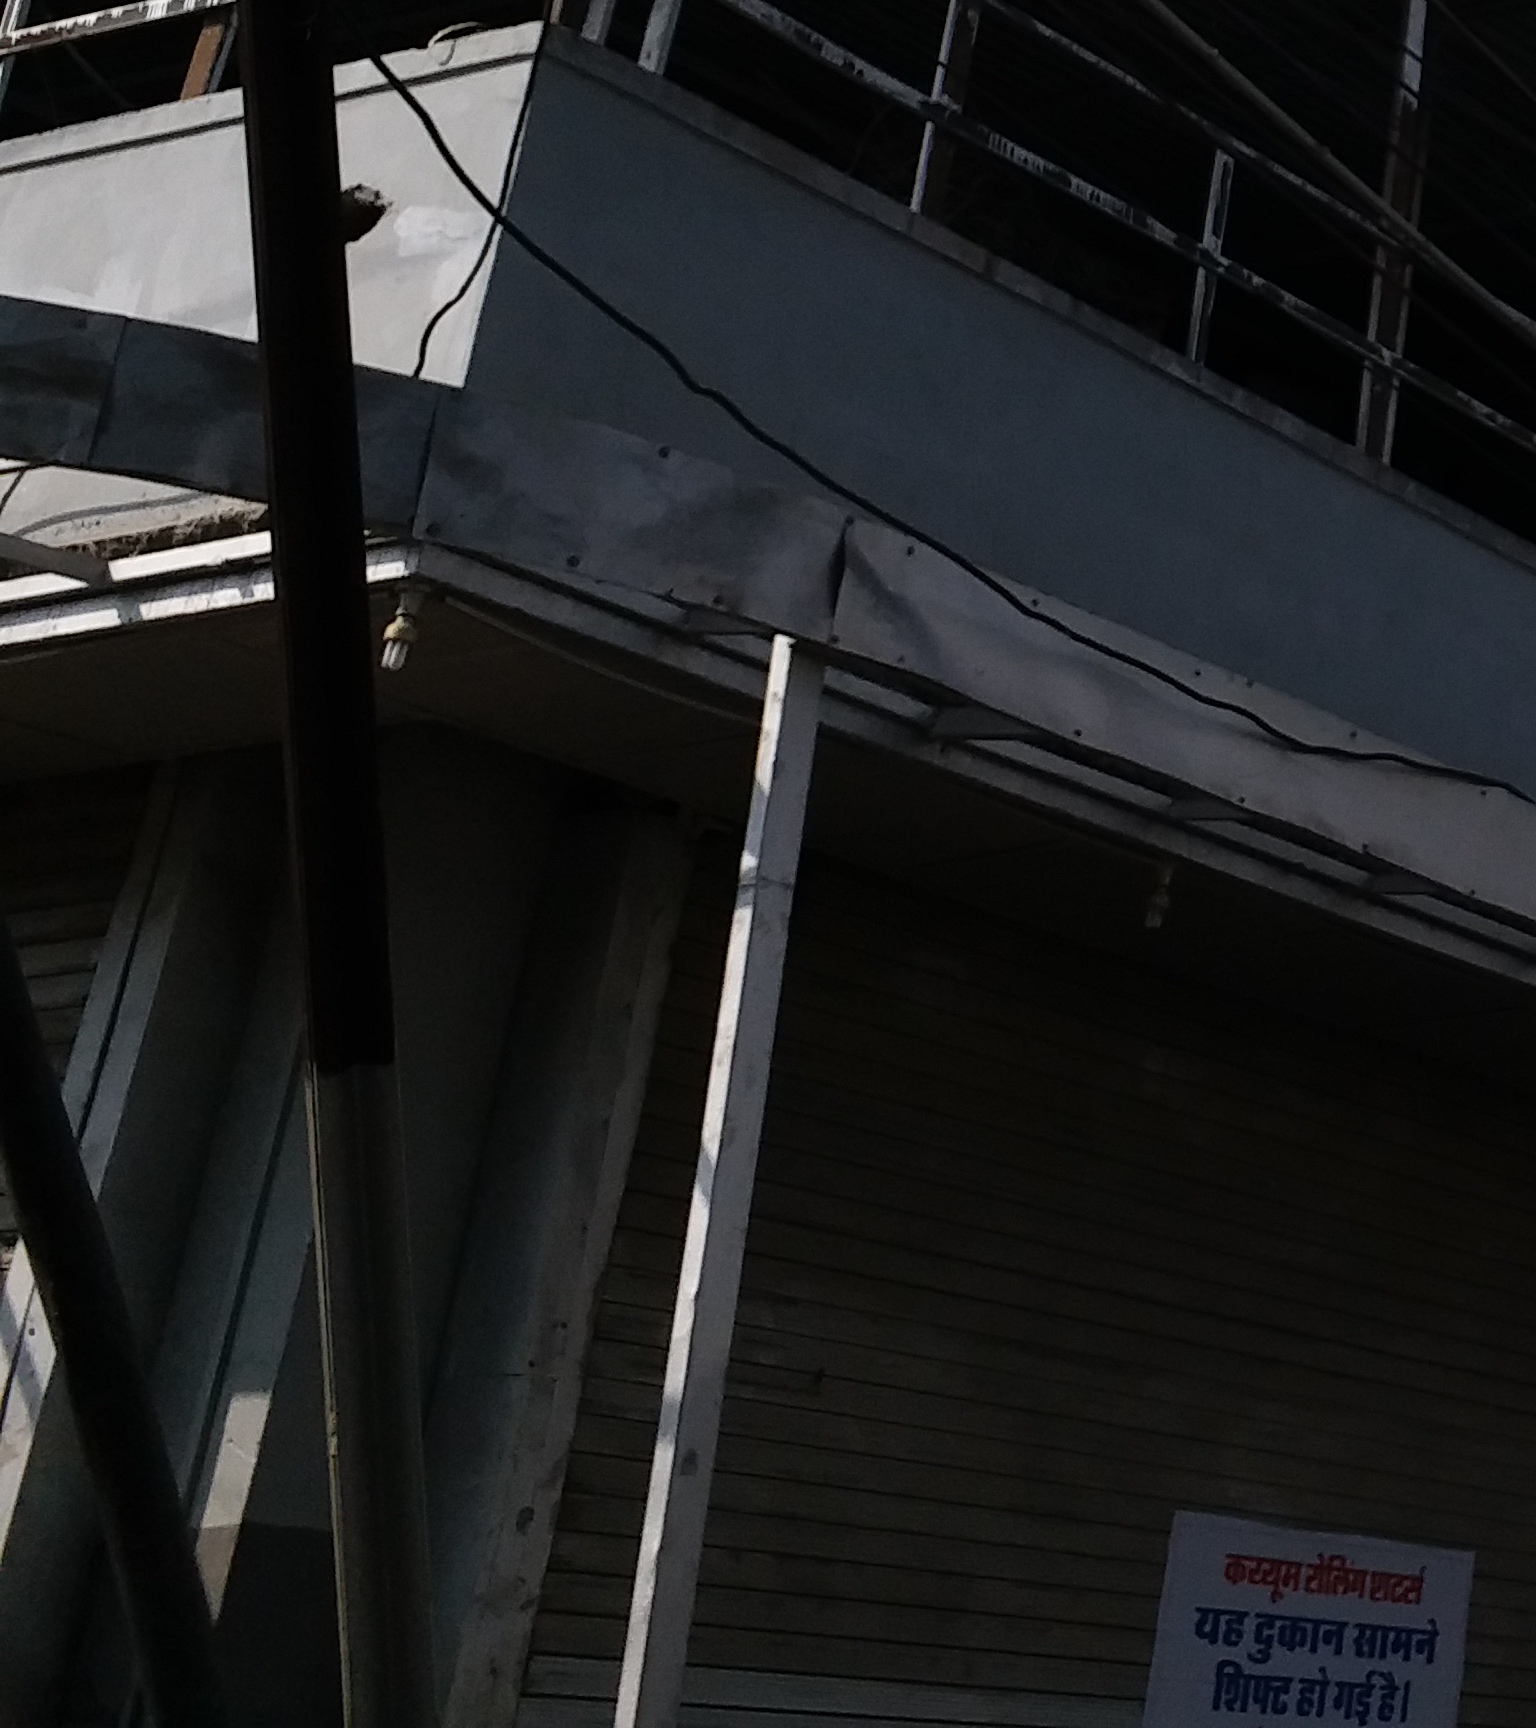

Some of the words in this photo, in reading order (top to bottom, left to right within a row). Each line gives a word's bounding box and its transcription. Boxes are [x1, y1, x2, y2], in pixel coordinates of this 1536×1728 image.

[1195, 1607, 1249, 1647] यह
[1247, 1613, 1349, 1664] दुकान
[1353, 1619, 1439, 1664] सामने
[1212, 1660, 1293, 1714] शिफ्ट
[1298, 1667, 1328, 1718] हो
